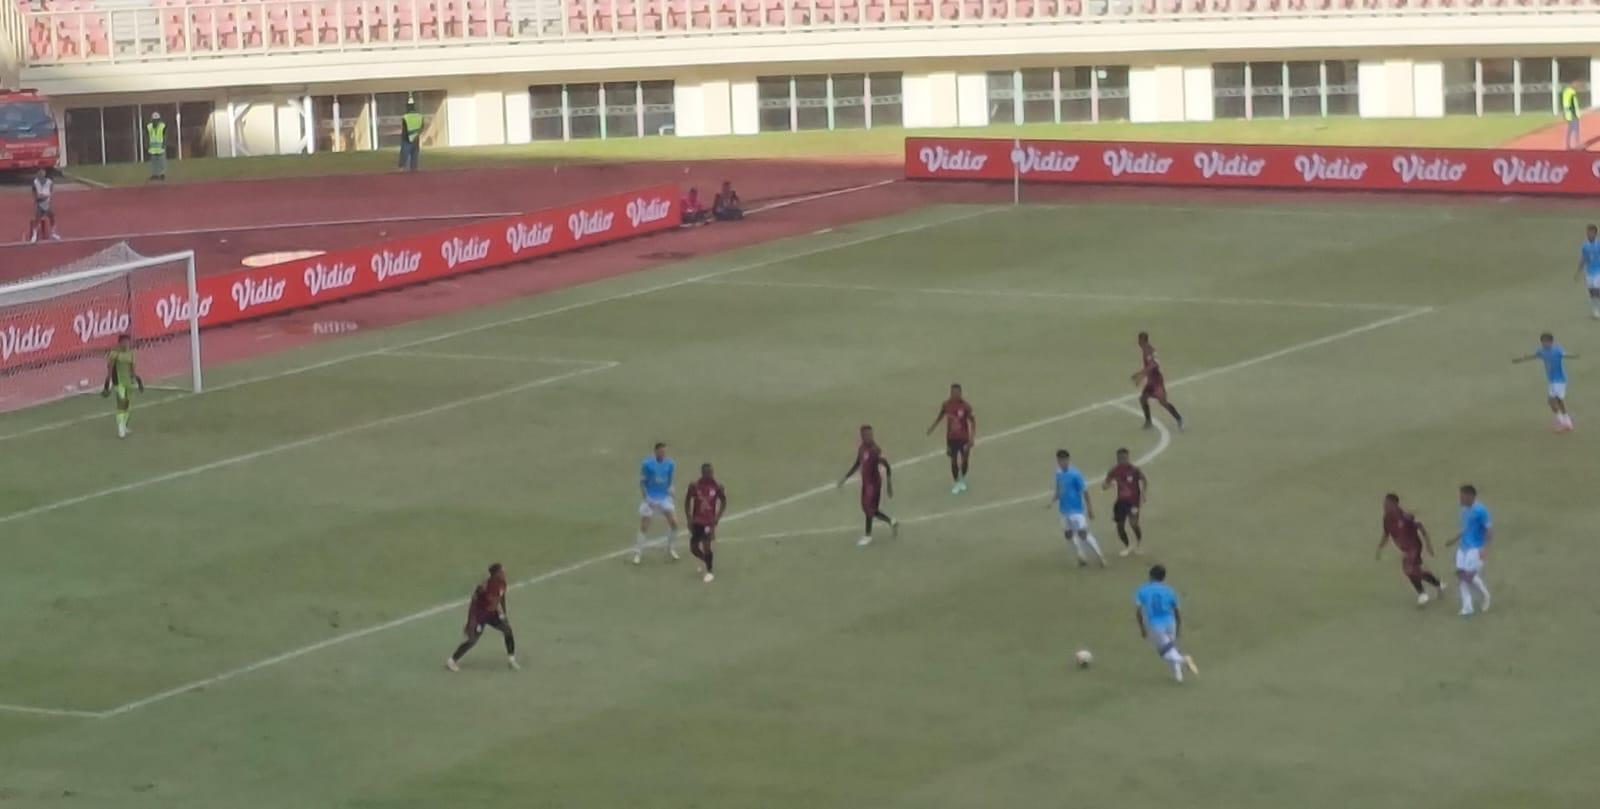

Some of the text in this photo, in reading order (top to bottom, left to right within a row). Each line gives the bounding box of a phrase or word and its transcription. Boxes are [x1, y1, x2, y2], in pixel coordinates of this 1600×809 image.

[920, 146, 987, 172] Vidio
[1011, 146, 1079, 174] Vidio
[1104, 149, 1172, 175] Vidio
[1194, 151, 1264, 178] Vidio
[1295, 154, 1367, 181] Vidio
[1393, 154, 1466, 182] Vidio
[1493, 157, 1568, 184] Vidio
[73, 309, 129, 343] Vidio
[232, 278, 285, 310] Vidio
[304, 262, 356, 295] Vidio
[371, 251, 421, 281] Vidio
[442, 238, 490, 267] Vidio
[507, 223, 553, 252] Vidio
[569, 210, 613, 240] Vidio
[627, 198, 670, 227] Vidio
